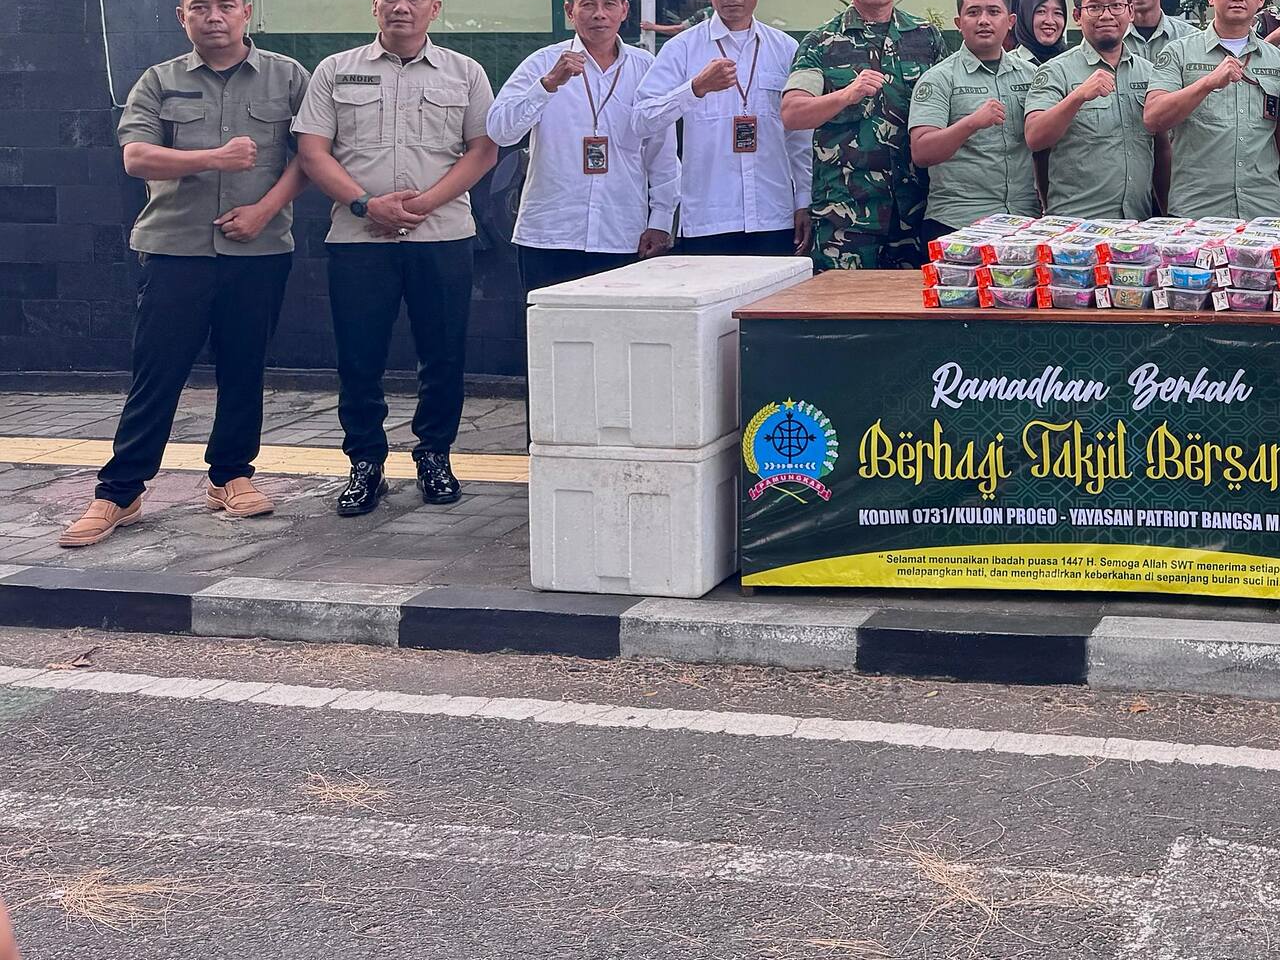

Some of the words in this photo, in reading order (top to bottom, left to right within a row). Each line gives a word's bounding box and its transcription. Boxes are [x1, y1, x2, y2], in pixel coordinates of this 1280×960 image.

[342, 75, 374, 83] ANDIK
[930, 361, 1111, 409] Ramadhan
[1127, 362, 1253, 411] Berkah
[759, 474, 822, 489] PAMUNGKAS
[858, 509, 910, 526] KODIM
[912, 507, 1003, 525] 0731/KULON
[1007, 508, 1057, 526] PROGO
[1069, 508, 1133, 526] YAYASAN
[1136, 509, 1198, 529] PATRIOT
[1201, 512, 1263, 531] BANGSA
[887, 555, 926, 564] Selamat
[929, 555, 989, 565] menunaikan
[992, 556, 1025, 566] ibadah
[1028, 558, 1058, 568] puasa
[1061, 557, 1083, 566] 1447
[1086, 557, 1097, 567] H.
[1100, 558, 1139, 570] Semoga
[1142, 559, 1168, 569] Allah
[1171, 560, 1194, 570] SWT
[1197, 561, 1247, 572] menerima
[1249, 564, 1280, 575] setiap
[897, 567, 963, 578] melapangkan
[966, 567, 987, 578] hati,
[990, 568, 1008, 577] dan
[1011, 568, 1082, 580] menghadirkan
[1084, 570, 1142, 581] keberkahan
[1144, 572, 1154, 581] di
[1157, 572, 1209, 585] sepanjang
[1212, 574, 1240, 585] bulan
[1242, 576, 1264, 586] suci
